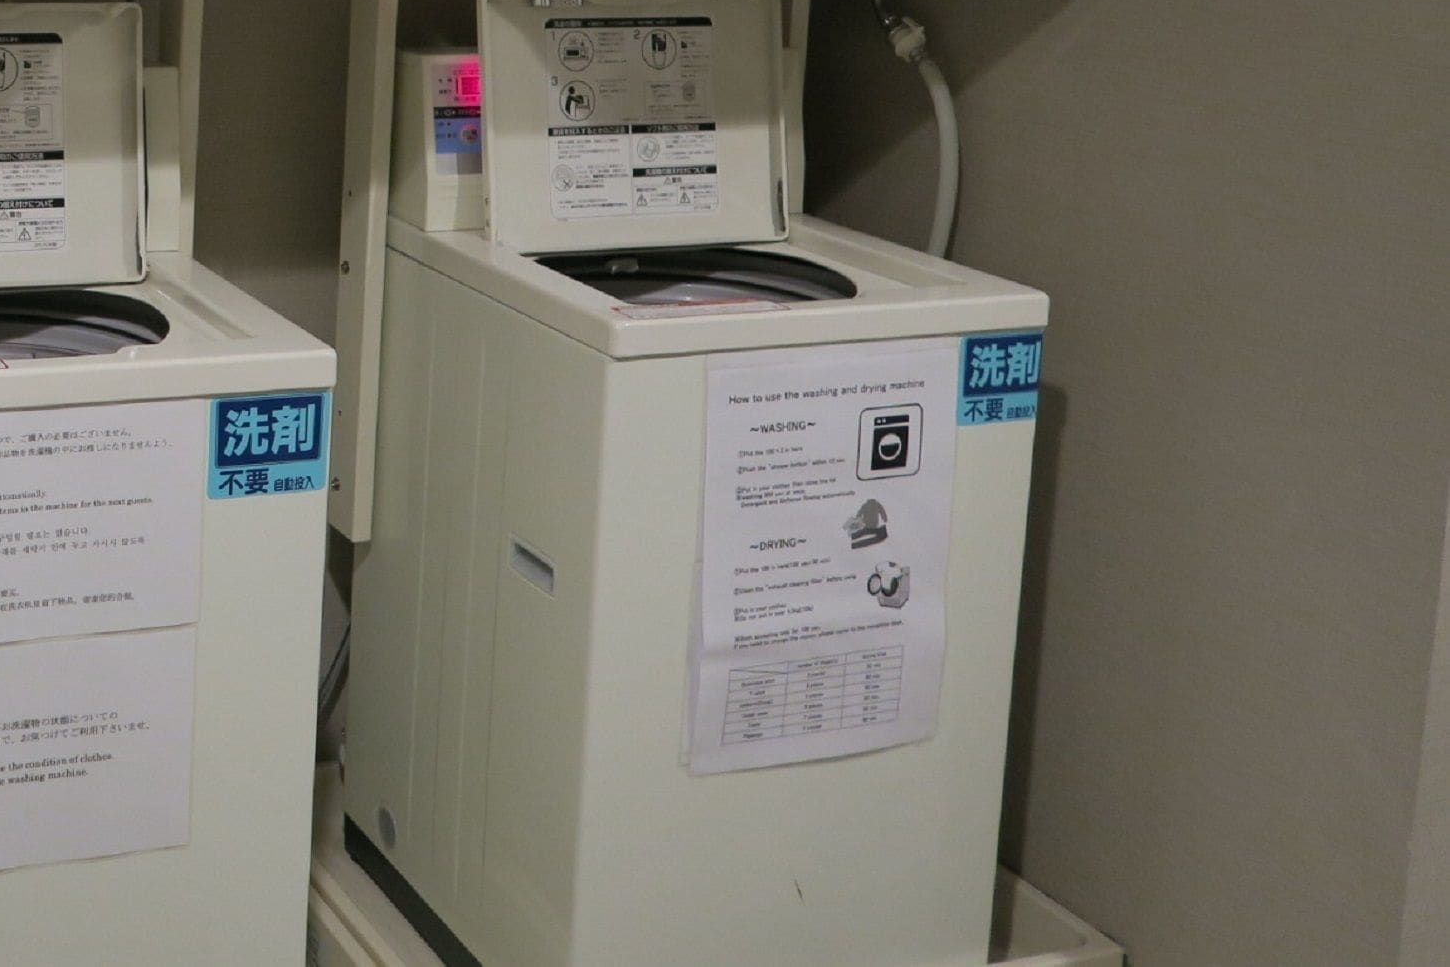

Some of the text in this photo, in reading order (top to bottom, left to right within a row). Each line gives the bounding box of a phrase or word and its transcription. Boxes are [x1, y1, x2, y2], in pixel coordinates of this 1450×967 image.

[969, 341, 1041, 388] 洗剤
[728, 379, 925, 404] How to use the washing and drying machine
[963, 398, 1004, 422] 不要
[224, 404, 316, 457] 洗剤
[219, 468, 315, 496] 不要 自動投入
[30, 504, 44, 513] the
[44, 501, 78, 512] machine
[80, 500, 91, 509] for
[93, 499, 107, 508] the
[108, 499, 126, 507] next
[8, 762, 24, 772] the
[25, 757, 67, 769] condition
[68, 755, 79, 764] of
[8, 773, 47, 786] washing
